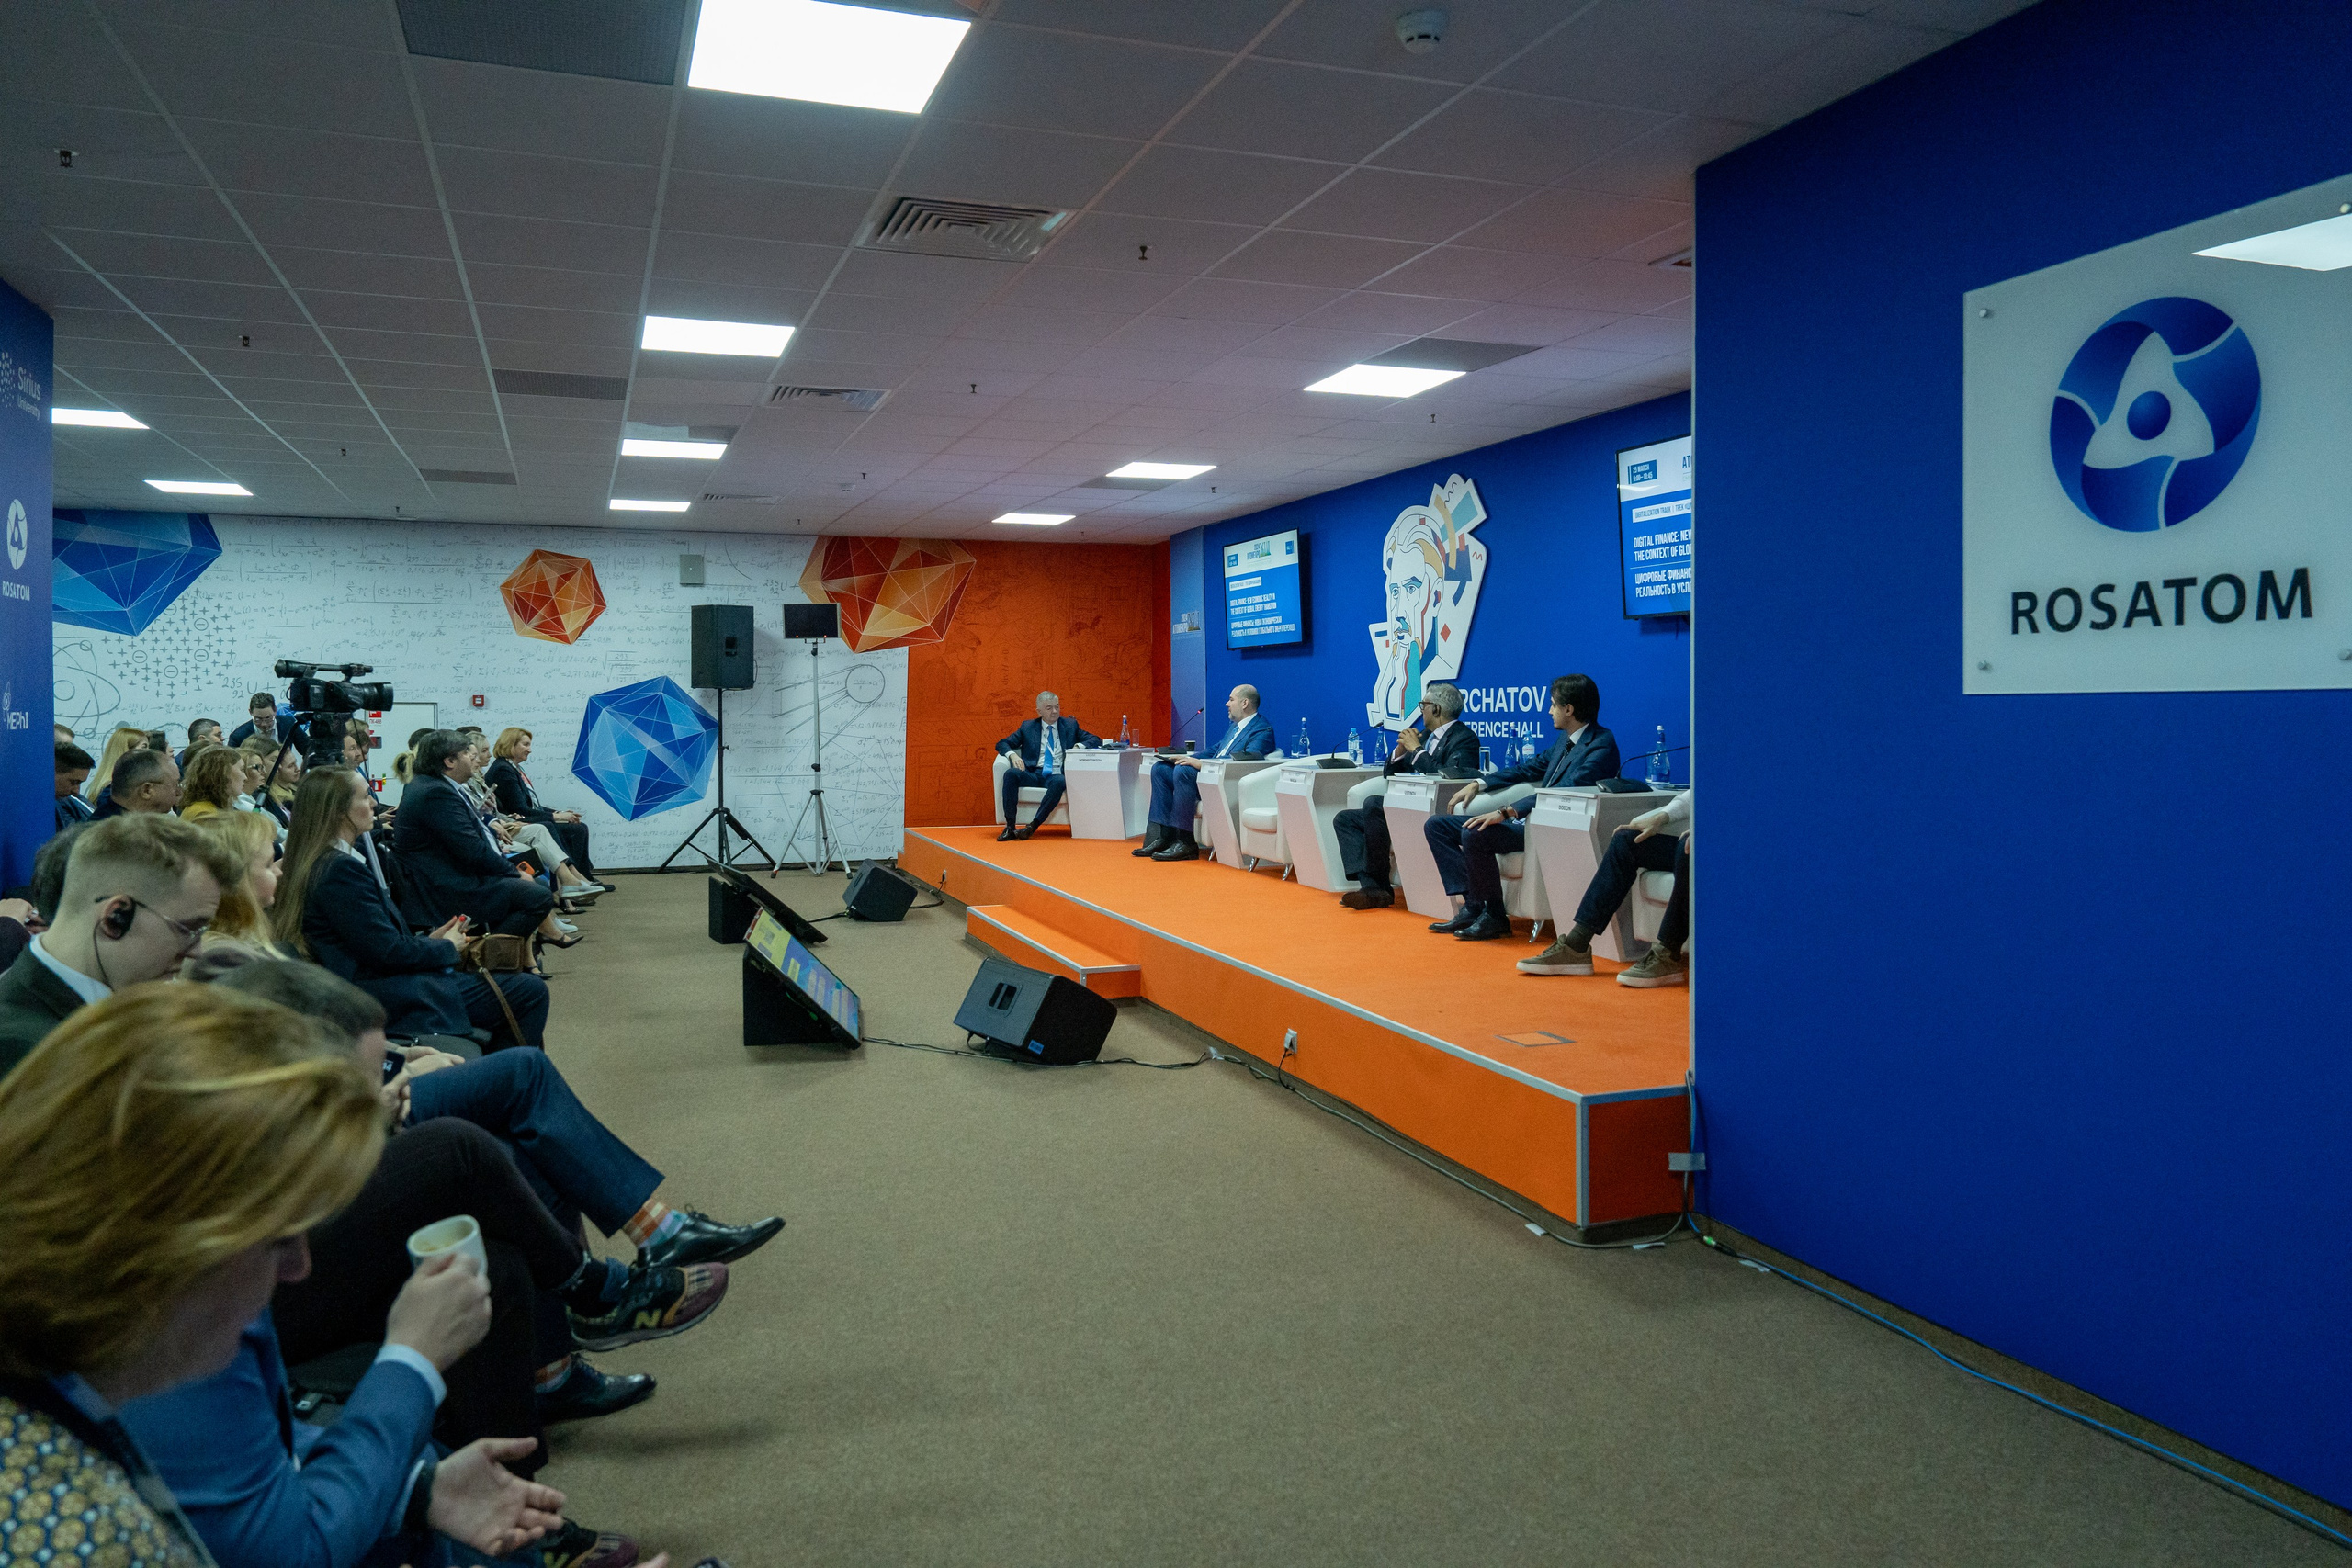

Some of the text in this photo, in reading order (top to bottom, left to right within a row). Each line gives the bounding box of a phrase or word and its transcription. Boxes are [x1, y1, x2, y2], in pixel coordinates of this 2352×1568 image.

[1634, 536, 1654, 548] DIGITAL
[1655, 531, 1679, 545] FINANCE:
[1634, 550, 1645, 561] THE
[1645, 547, 1669, 560] CONTEXT
[1671, 546, 1678, 558] OF
[1635, 570, 1667, 584] ЦИФРОВЫЕ
[2, 580, 30, 601] ROSATOM
[1636, 584, 1671, 598] РЕАЛЬНОСТЬ
[1671, 583, 1676, 594] В
[2011, 567, 2313, 635] ROSATOM
[1458, 686, 1547, 713] RCHATOV
